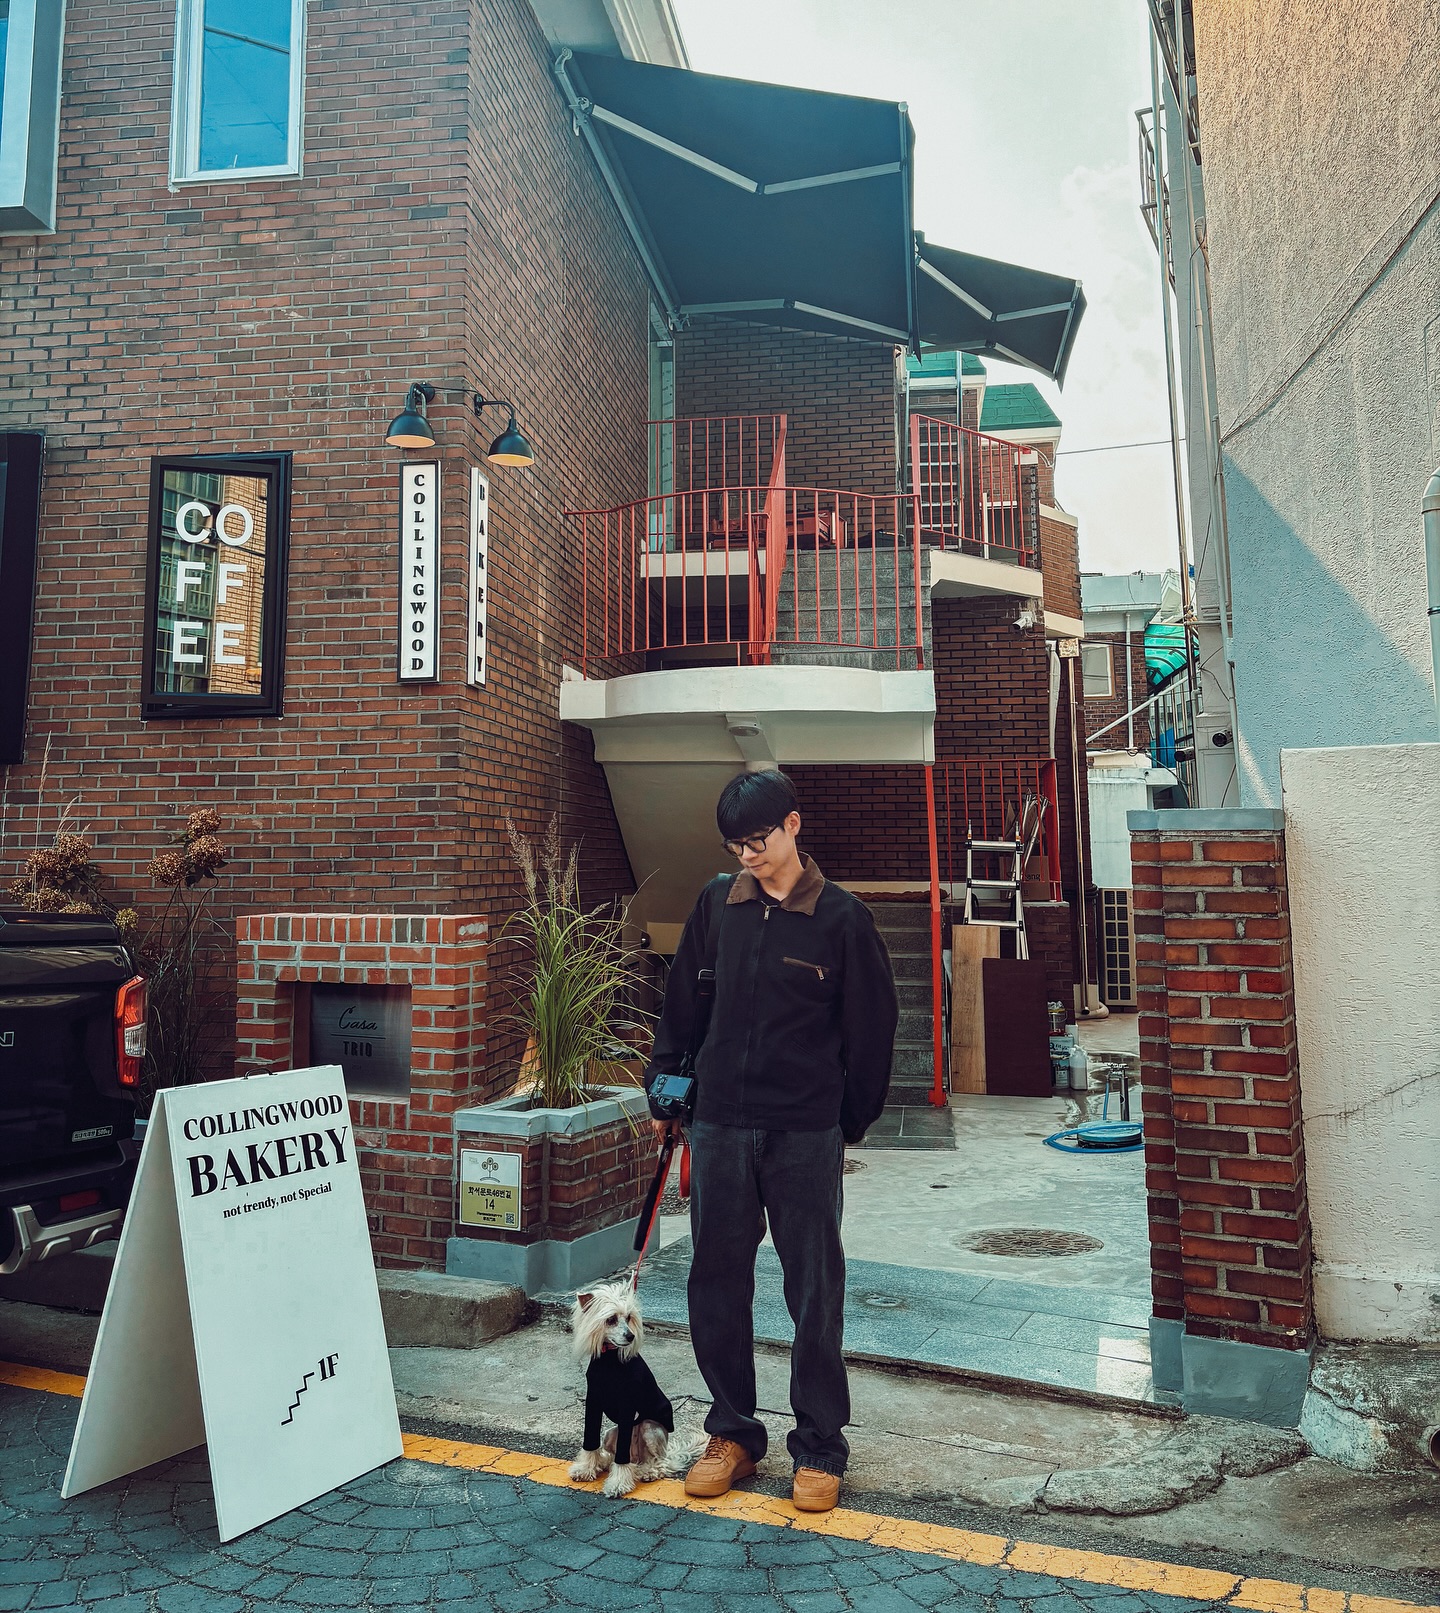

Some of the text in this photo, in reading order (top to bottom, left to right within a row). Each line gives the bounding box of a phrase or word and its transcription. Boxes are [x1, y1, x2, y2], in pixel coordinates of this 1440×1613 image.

[410, 474, 427, 671] COLLINGWOOD
[477, 484, 486, 672] BAKERY
[338, 1005, 378, 1030] Casa
[343, 1041, 373, 1057] TRIO
[183, 1094, 343, 1141] COLLINGWOOD
[186, 1126, 348, 1197] BAKERY
[223, 1182, 332, 1218] not trendy, not Special
[485, 1198, 496, 1210] 14
[317, 1352, 339, 1381] 1F
